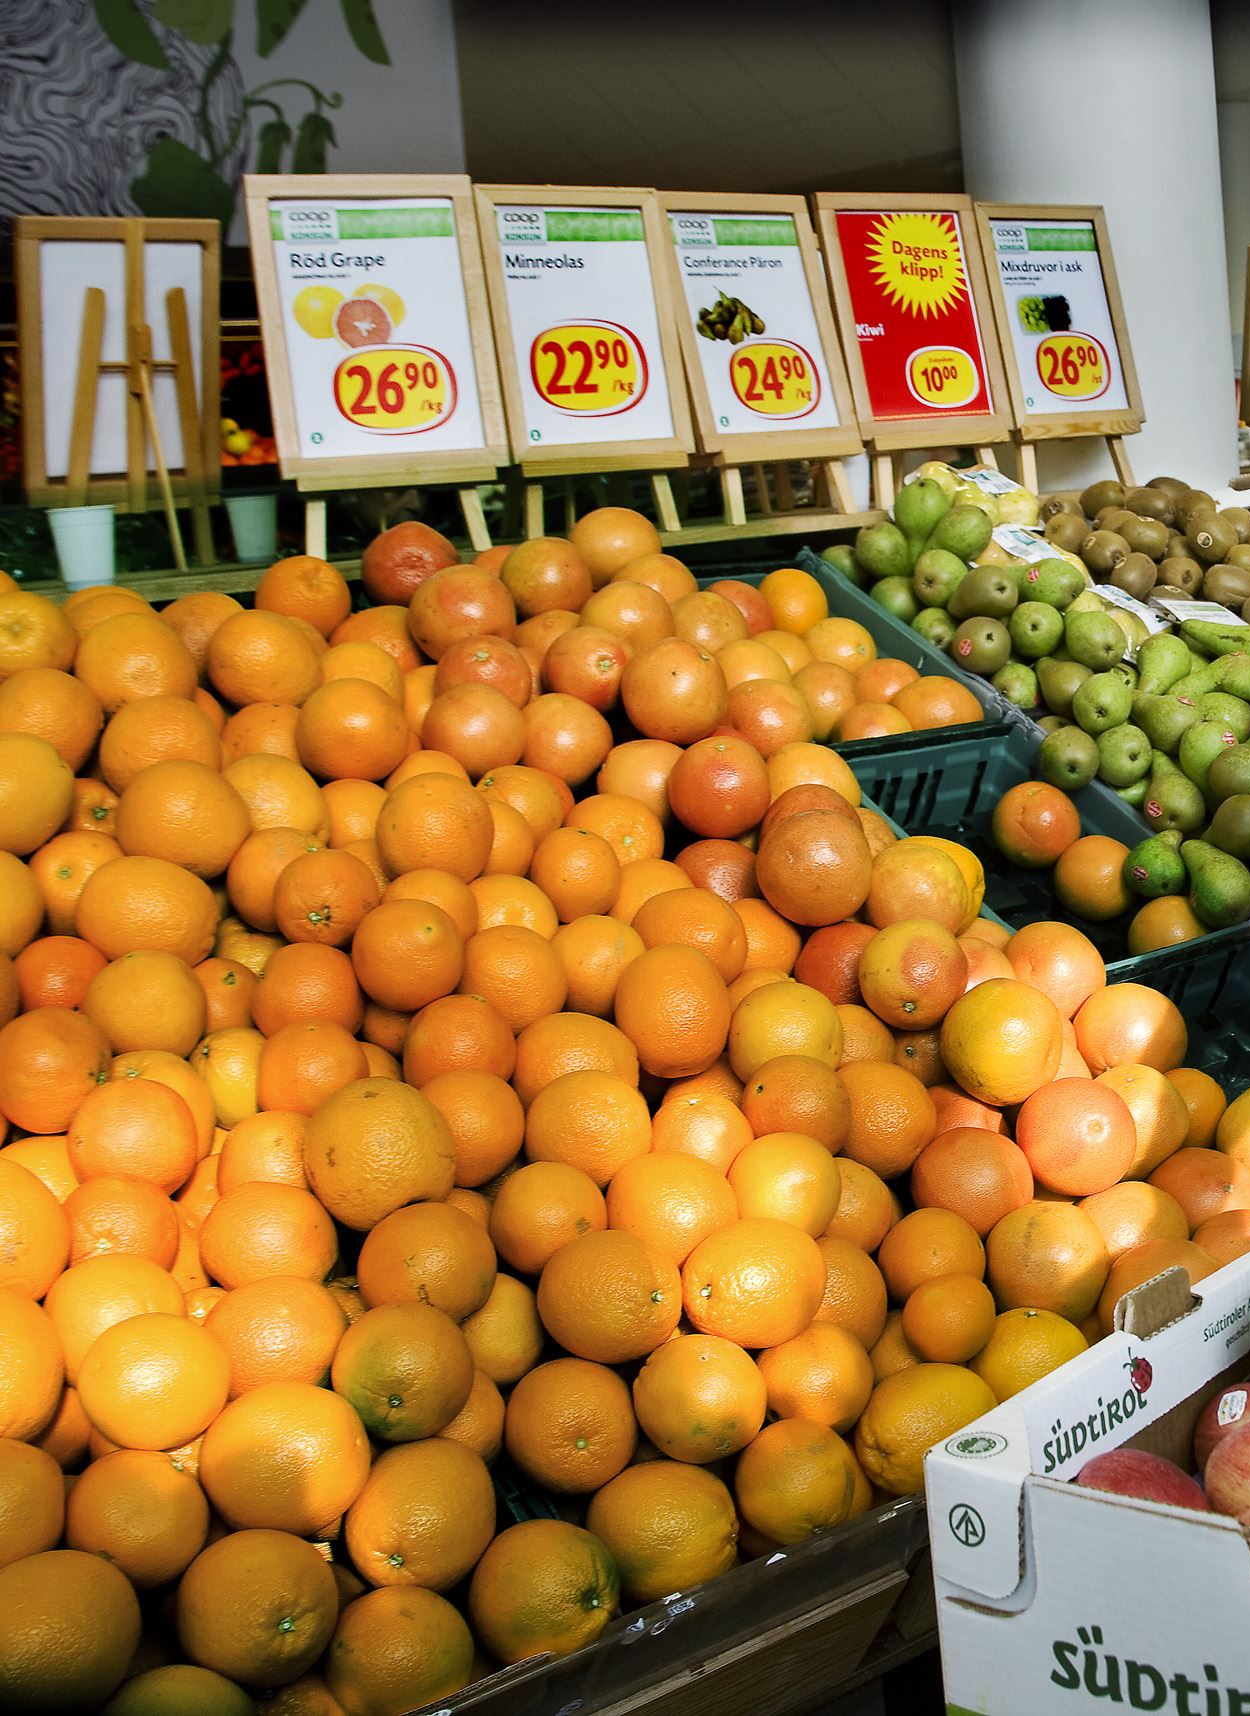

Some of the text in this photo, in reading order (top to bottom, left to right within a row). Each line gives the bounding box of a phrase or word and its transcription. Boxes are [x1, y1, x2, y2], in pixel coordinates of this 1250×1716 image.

[504, 213, 539, 224] coop
[892, 240, 948, 261] Dagens
[290, 252, 386, 272] Röd Grape
[505, 254, 585, 269] Minneolas
[749, 256, 783, 269] Päron
[1001, 260, 1057, 273] Mixdruvor
[1065, 260, 1083, 273] ask
[900, 261, 943, 282] klipp!
[856, 322, 885, 336] Kiwi
[1203, 1304, 1246, 1342] Südtiroler
